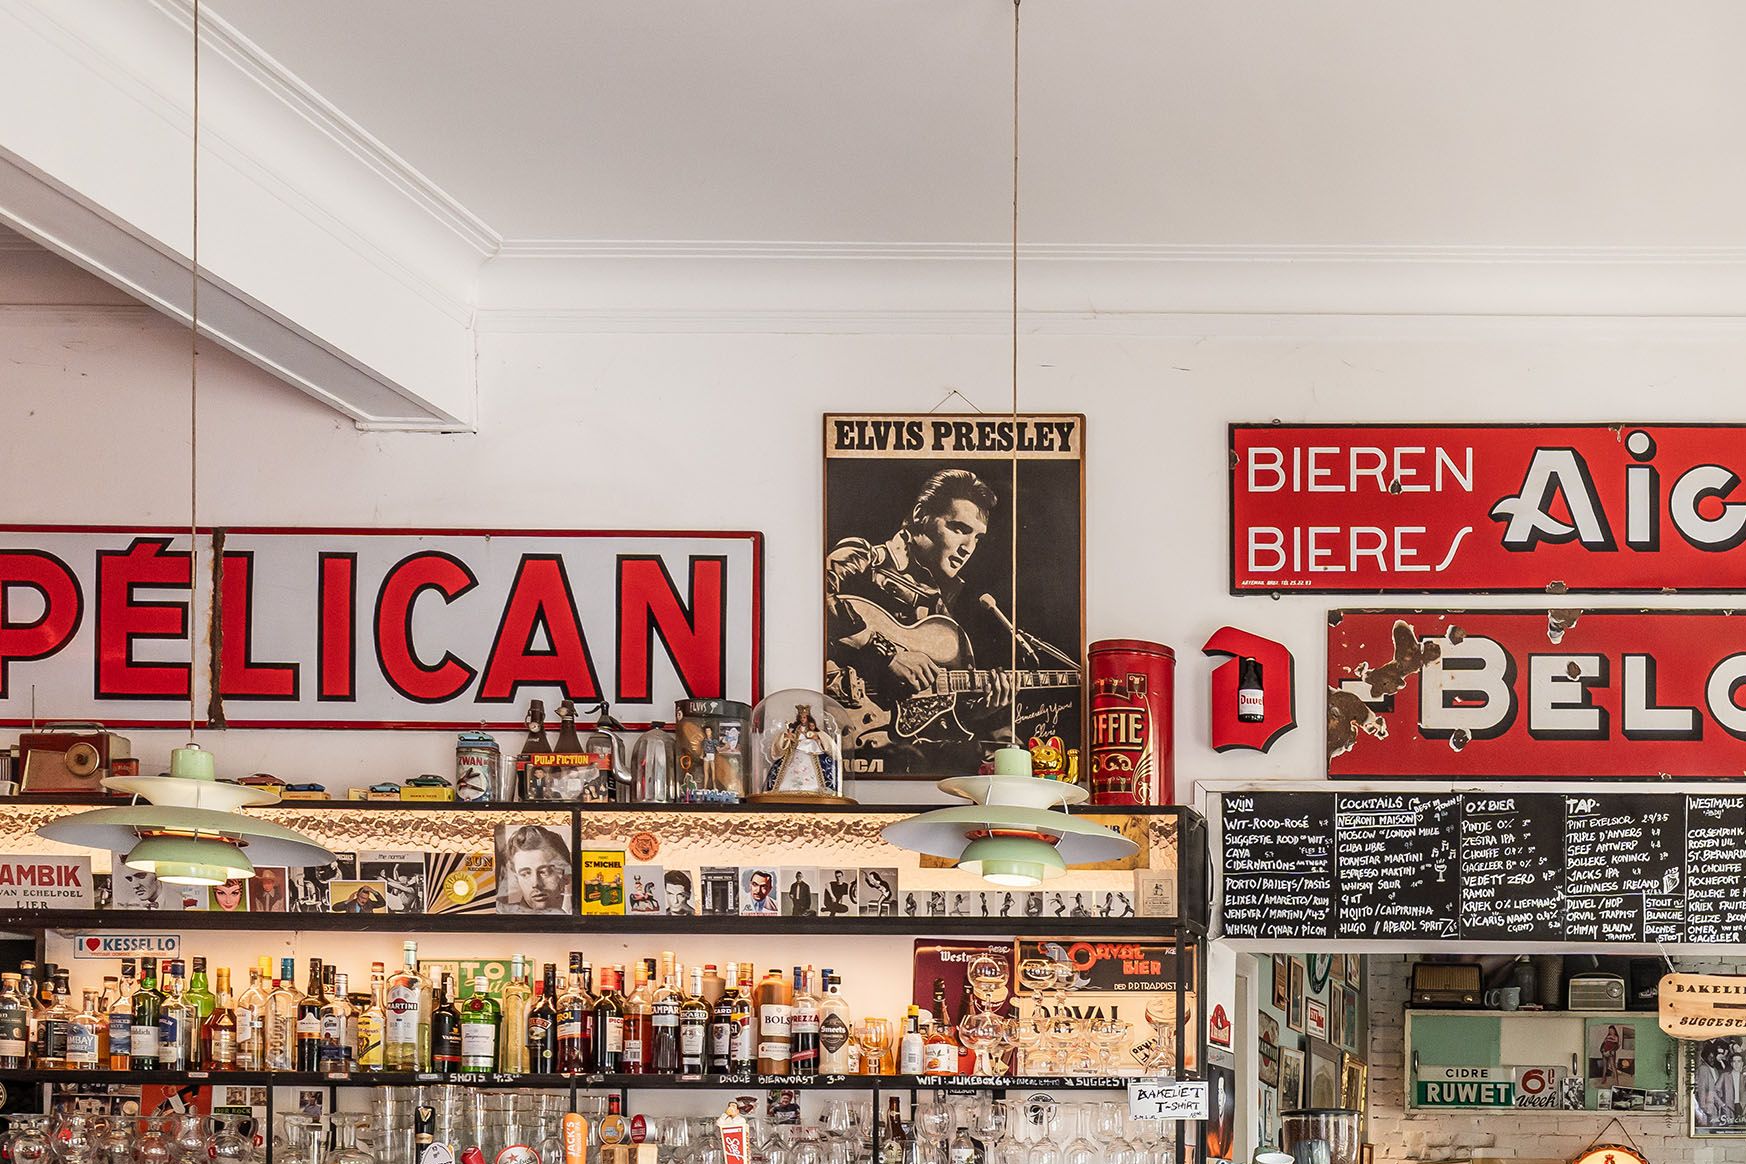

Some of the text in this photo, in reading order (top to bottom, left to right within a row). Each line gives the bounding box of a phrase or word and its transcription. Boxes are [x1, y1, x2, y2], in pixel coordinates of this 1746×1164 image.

[834, 420, 1075, 453] ELVIS PRESLEY
[1248, 446, 1473, 493] BIEREN
[1248, 526, 1473, 573] BIERES
[1090, 711, 1144, 746] FFIE
[534, 754, 589, 766] PULP FICTION
[1340, 796, 1403, 809] COCKTAILS
[1689, 797, 1744, 810] WESTMALLE
[1338, 815, 1414, 827] NEGRONI MAISON
[465, 856, 493, 867] SUN
[593, 861, 622, 869] MICHEL
[16, 901, 49, 909] LIER
[1340, 922, 1366, 934] HUGO
[450, 1073, 486, 1083] SHOTS
[1445, 1068, 1490, 1079] CIDRE
[1137, 1086, 1204, 1100] BAKELIET
[1426, 1083, 1511, 1105] RUWET
